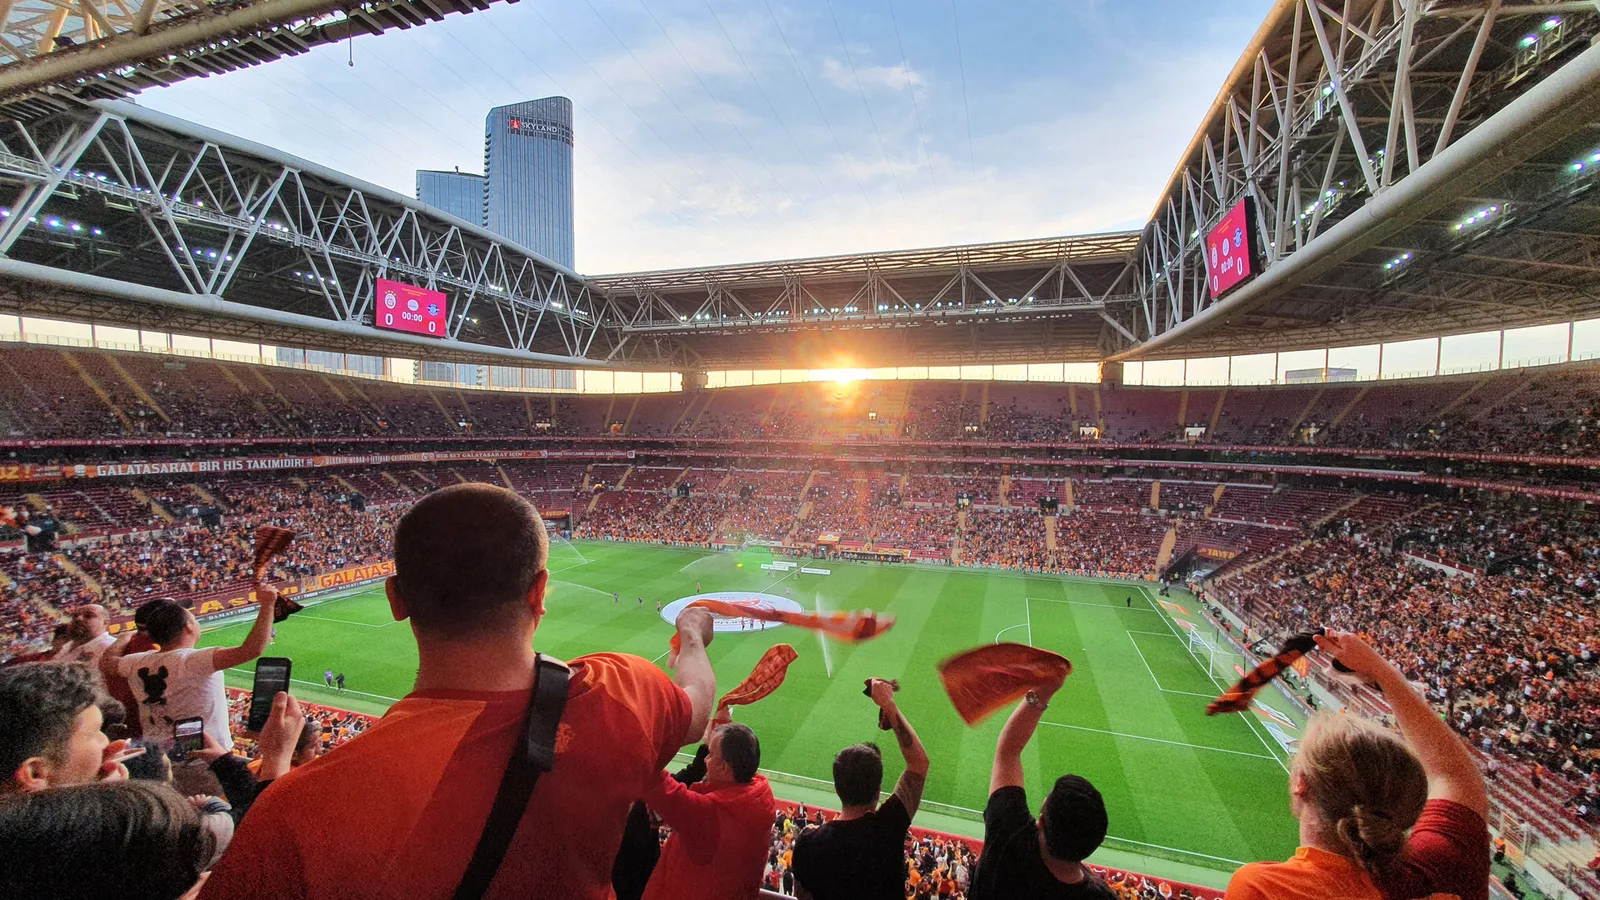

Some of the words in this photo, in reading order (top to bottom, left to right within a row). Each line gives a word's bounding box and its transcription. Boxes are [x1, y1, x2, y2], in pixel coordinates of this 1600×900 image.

[521, 122, 558, 133] SKYLAND
[1237, 256, 1243, 276] 0
[1213, 275, 1219, 292] 0
[385, 313, 394, 326] 0
[402, 311, 423, 323] 00:00
[428, 321, 436, 333] 0
[97, 462, 194, 477] GALATASARAY
[246, 458, 305, 470] TAKIMIDIR!
[1208, 548, 1235, 560] TAYFA
[208, 611, 234, 621] DAMAT
